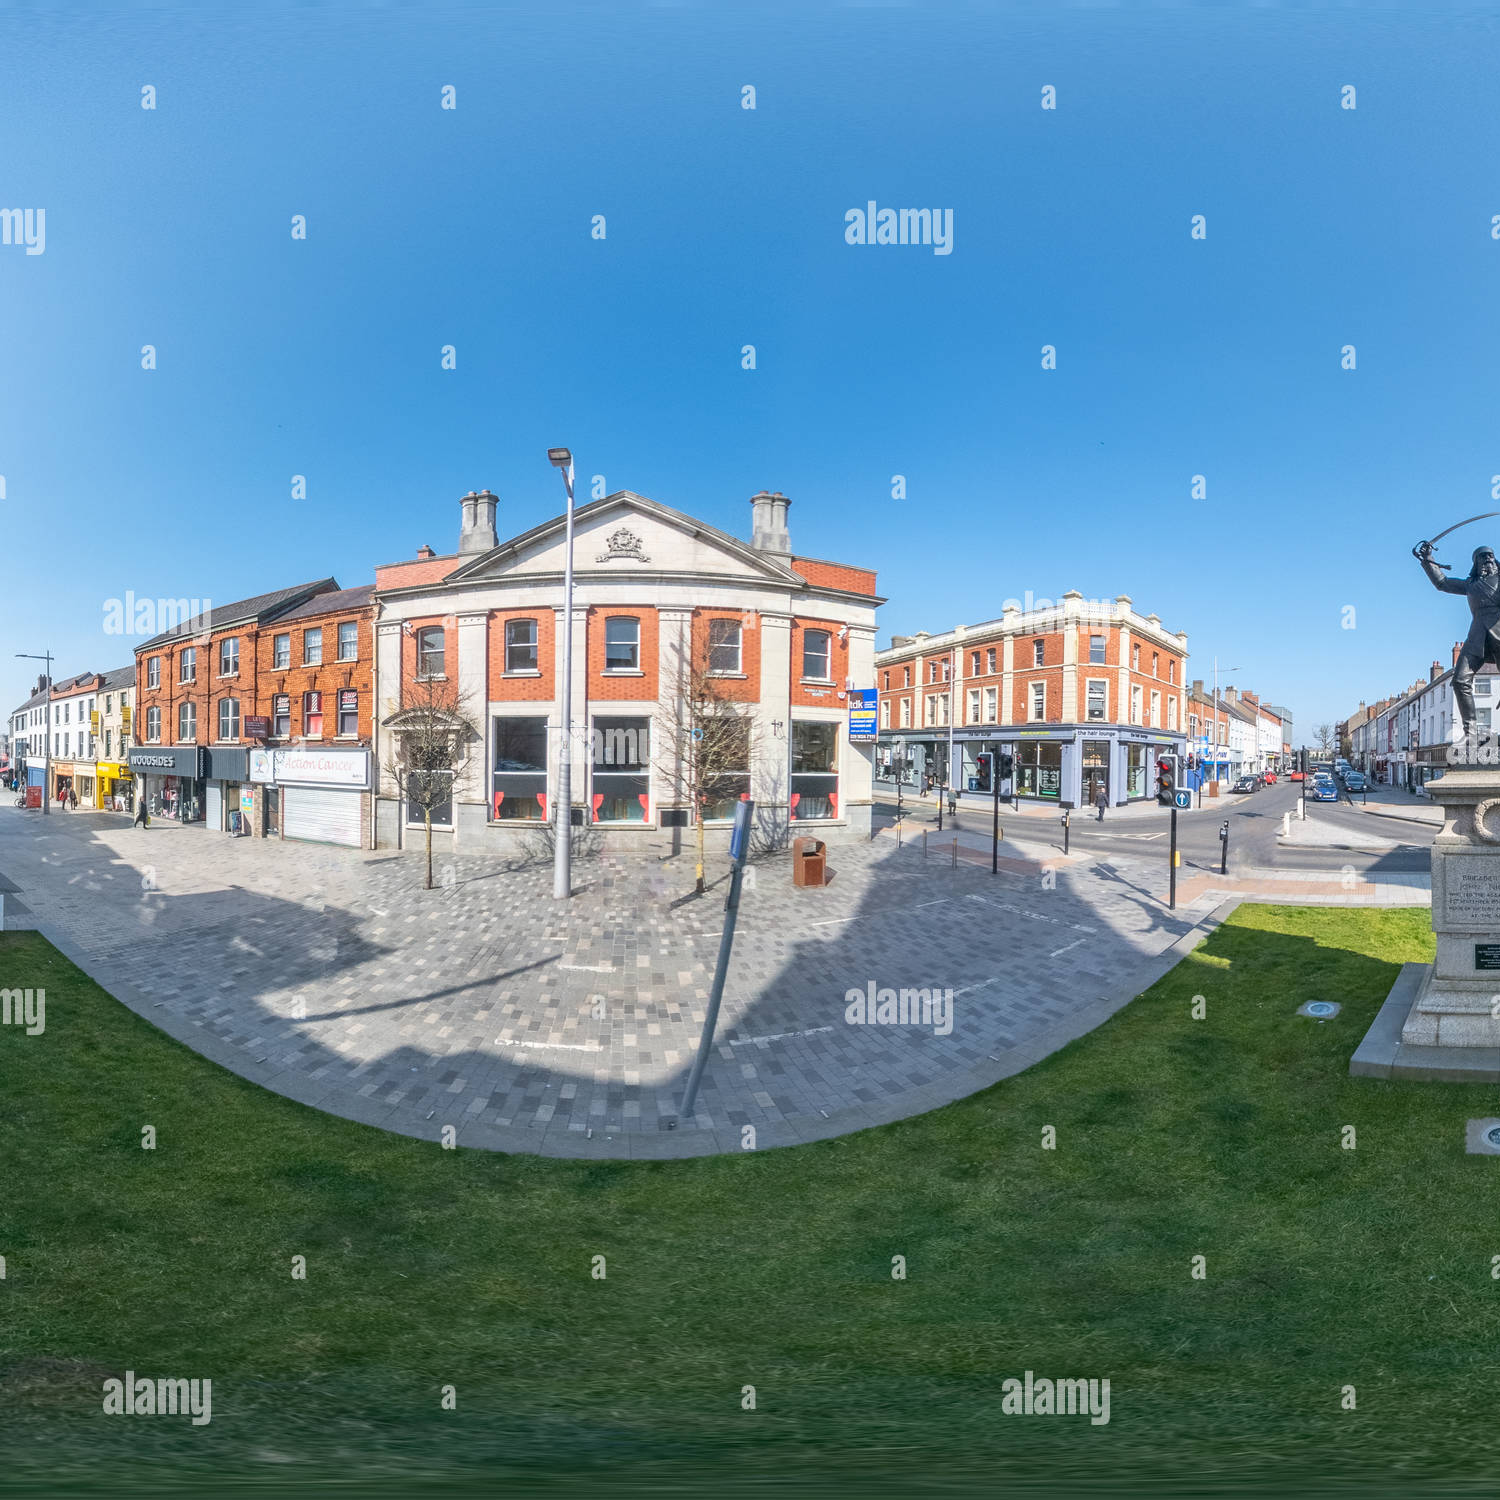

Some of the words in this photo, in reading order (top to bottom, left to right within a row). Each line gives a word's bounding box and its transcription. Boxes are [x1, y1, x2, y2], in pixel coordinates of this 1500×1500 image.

[130, 755, 174, 767] WOODSIDES
[285, 758, 316, 770] Action
[318, 758, 354, 771] Cancer
